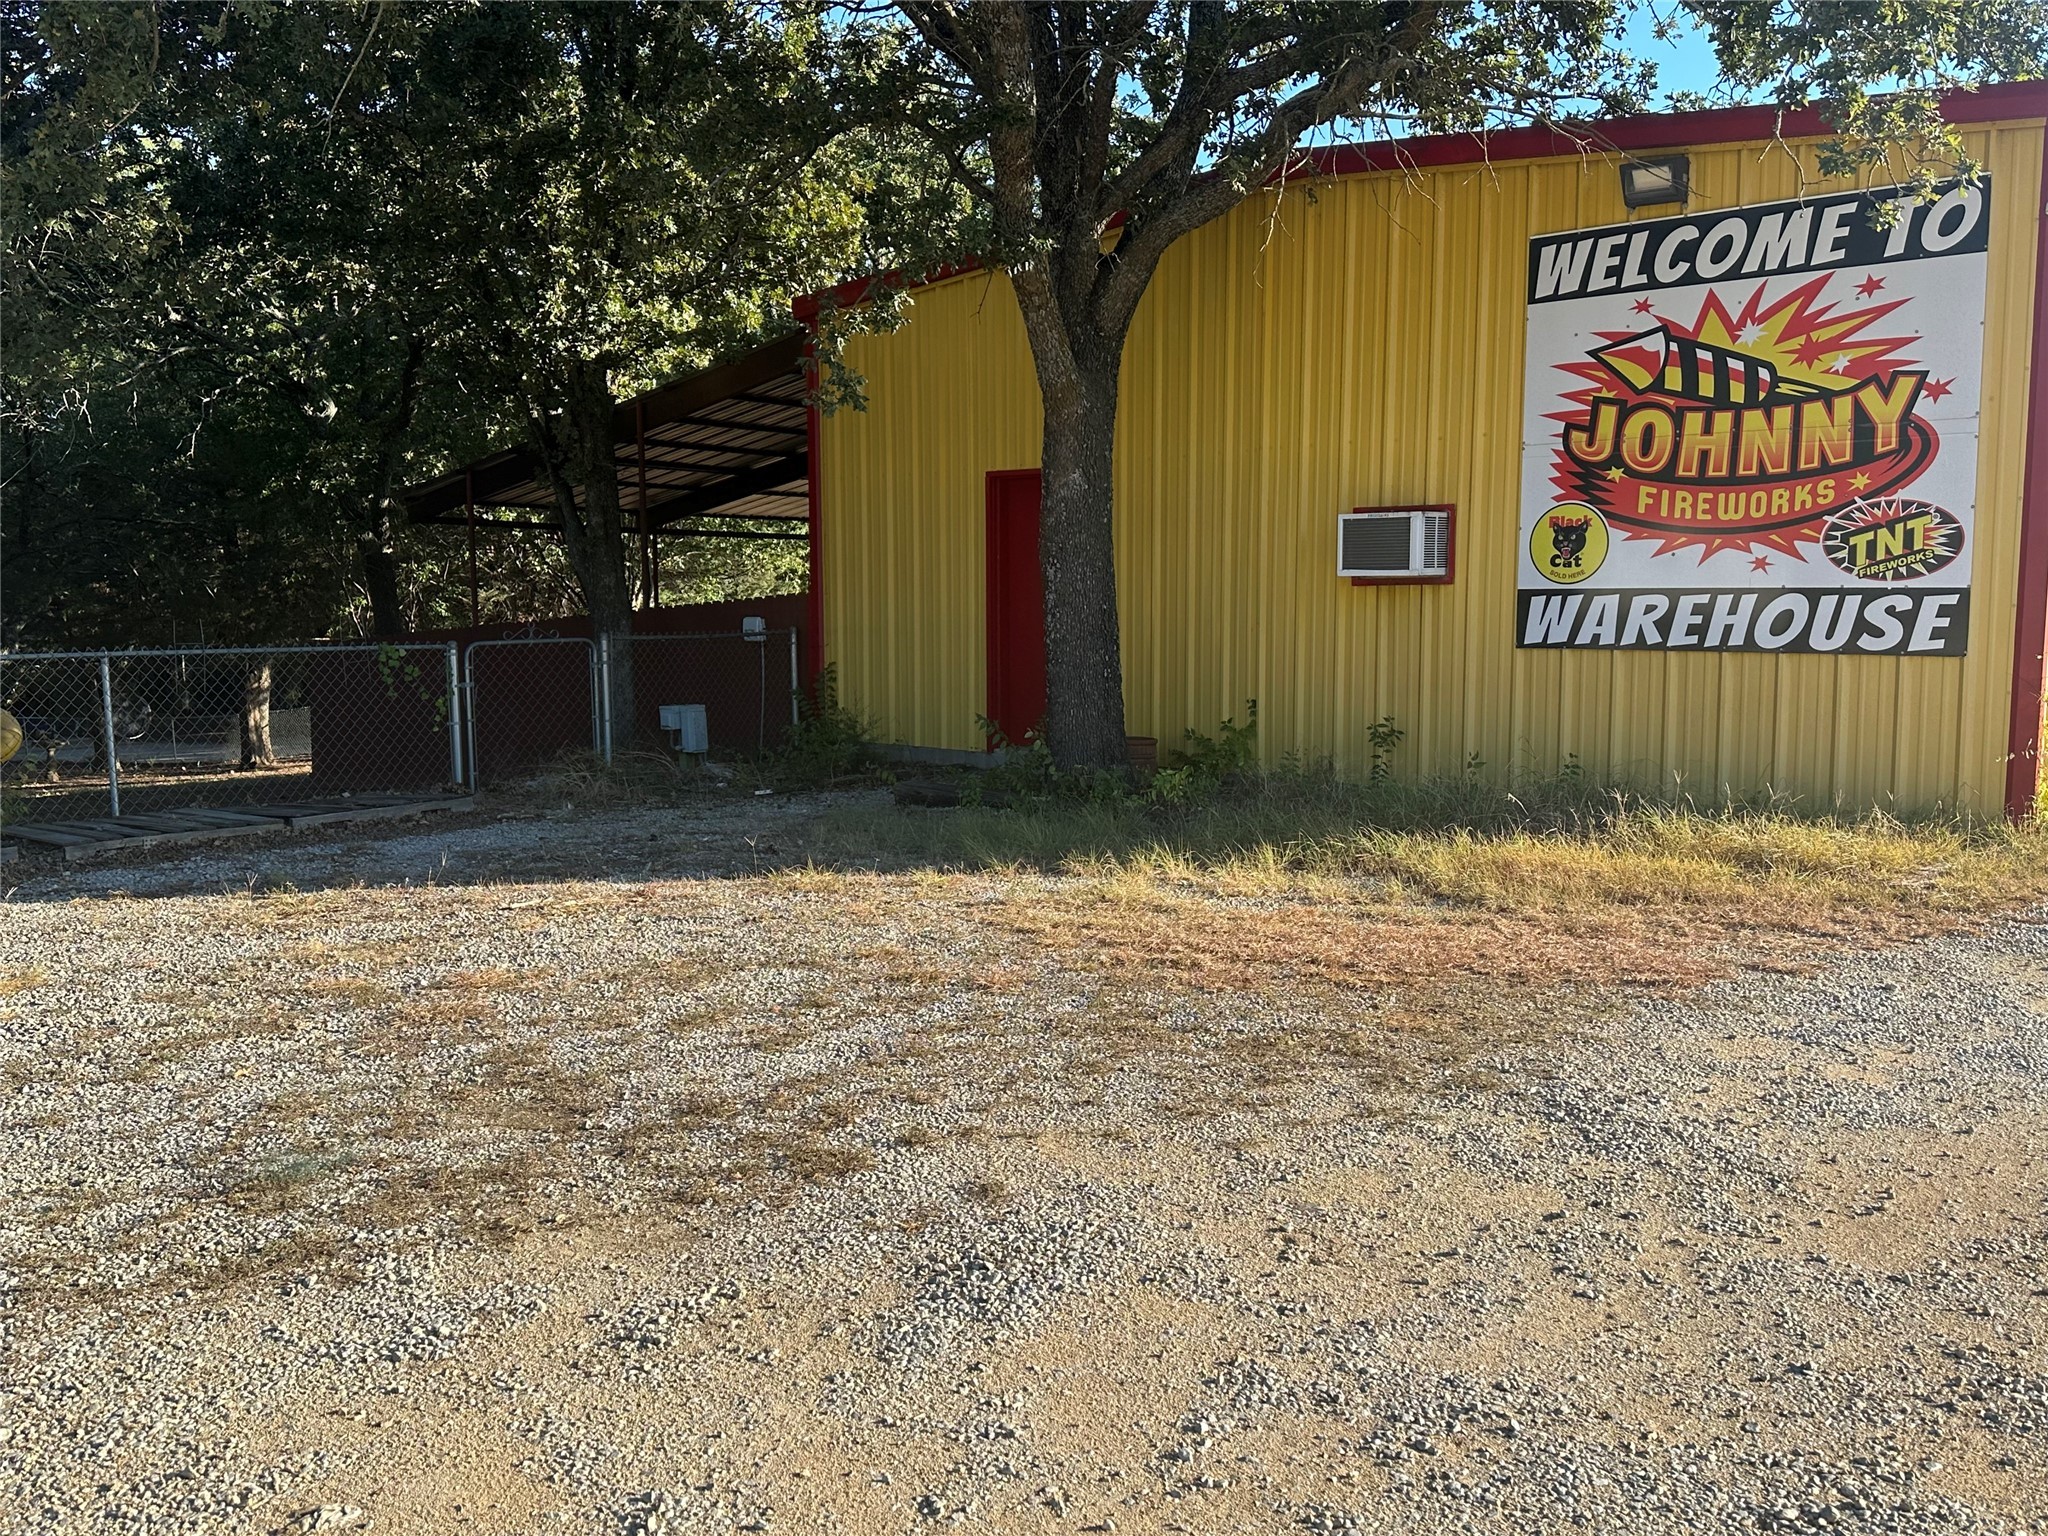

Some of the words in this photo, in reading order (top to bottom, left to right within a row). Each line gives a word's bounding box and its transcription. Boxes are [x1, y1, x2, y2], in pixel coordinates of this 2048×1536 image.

[1534, 201, 1859, 300] WELCOME
[1881, 186, 1983, 258] TO
[1568, 375, 1916, 478] JOHNNY
[1637, 478, 1836, 521] FIREWORKS
[1548, 514, 1593, 529] Black
[1849, 514, 1932, 567] TNT
[1549, 553, 1583, 568] Cat
[1549, 569, 1567, 579] SOLD
[1567, 569, 1586, 579] HERE
[1858, 549, 1935, 578] FIREWORKS
[1523, 593, 1961, 652] WAREHOUSE
